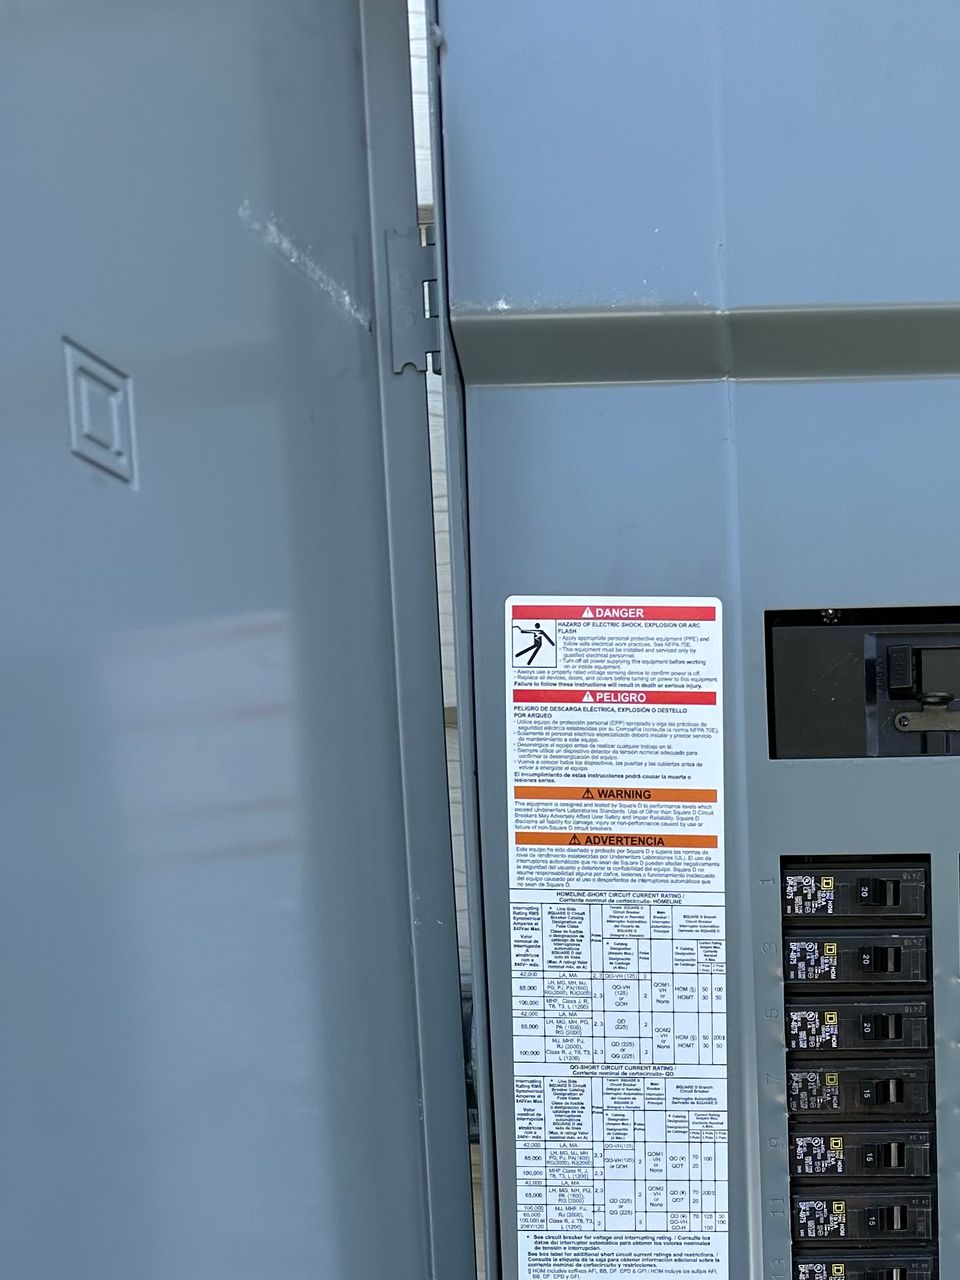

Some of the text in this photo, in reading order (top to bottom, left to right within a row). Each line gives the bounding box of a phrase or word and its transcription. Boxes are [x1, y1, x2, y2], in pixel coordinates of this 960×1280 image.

[596, 608, 644, 617] DANGER
[596, 693, 646, 702] PELIGRO
[597, 789, 651, 799] WARNING
[585, 836, 665, 846] ADVERTENCIA
[861, 887, 868, 897] 20
[862, 954, 870, 965] 20
[864, 1022, 871, 1033] 20
[864, 1089, 871, 1099] 15
[866, 1153, 873, 1162] 15
[869, 1216, 876, 1225] 15
